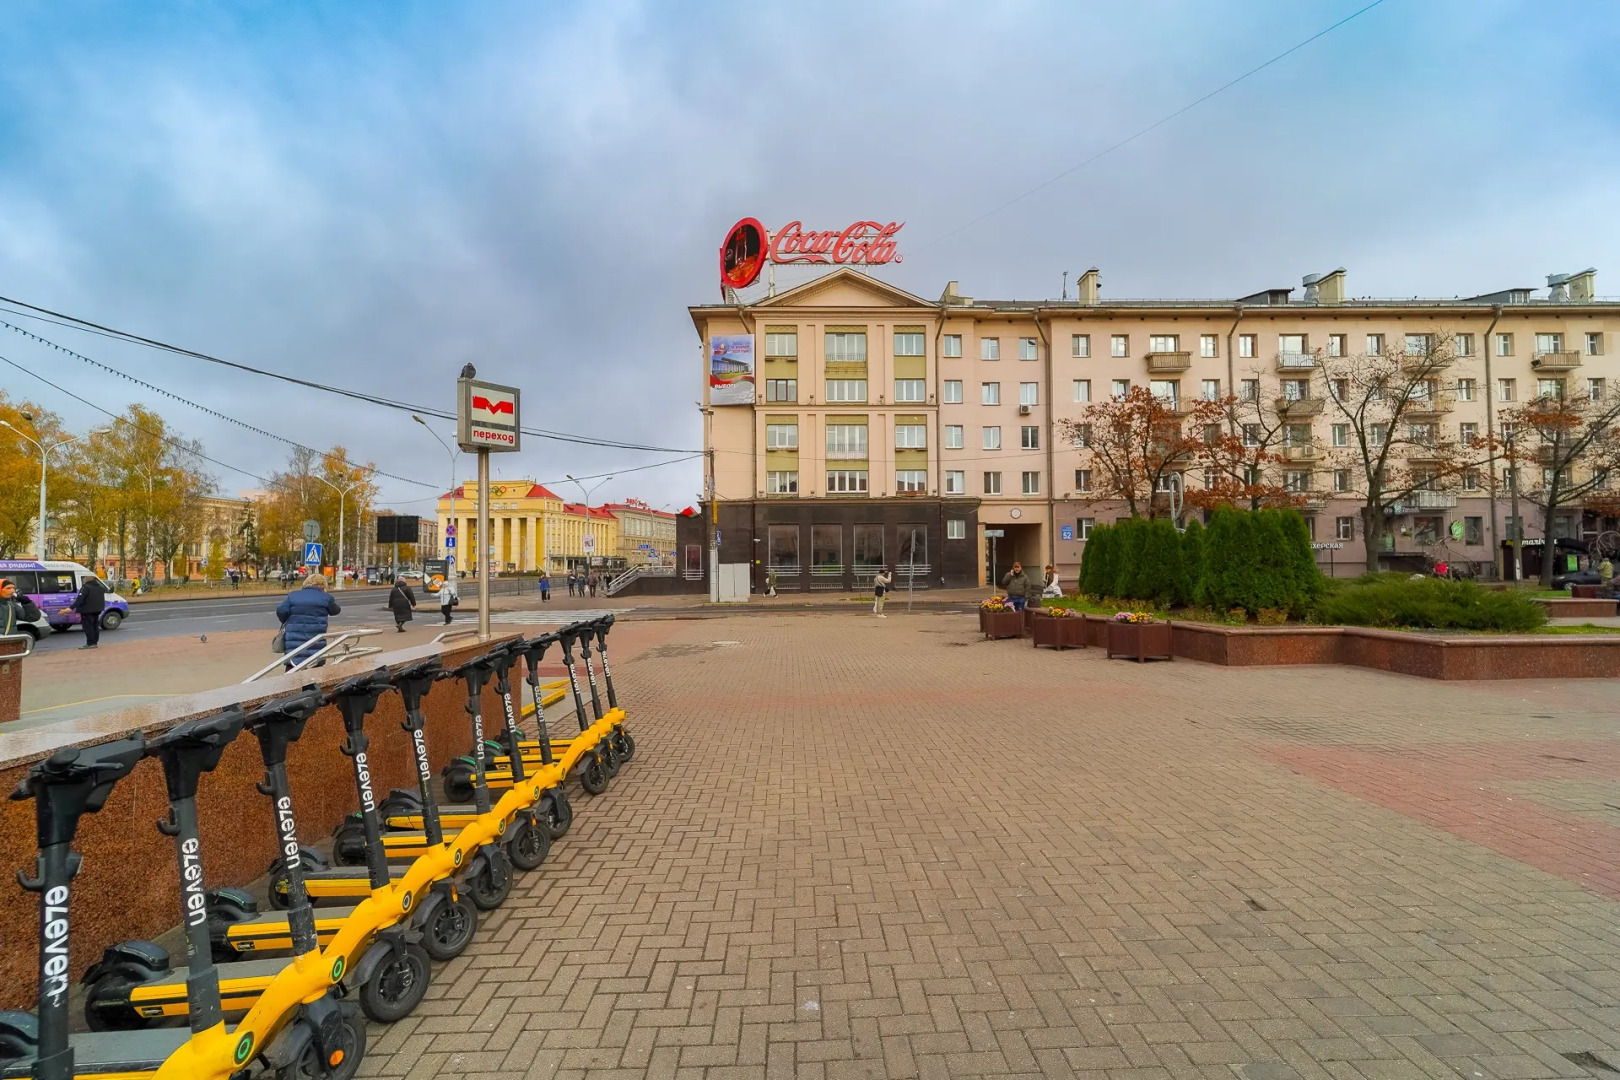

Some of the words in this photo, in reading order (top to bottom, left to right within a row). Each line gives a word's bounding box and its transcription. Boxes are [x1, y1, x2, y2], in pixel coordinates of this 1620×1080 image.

[770, 220, 906, 265] Coca-Cola
[473, 430, 514, 444] переход
[1062, 532, 1072, 540] 52
